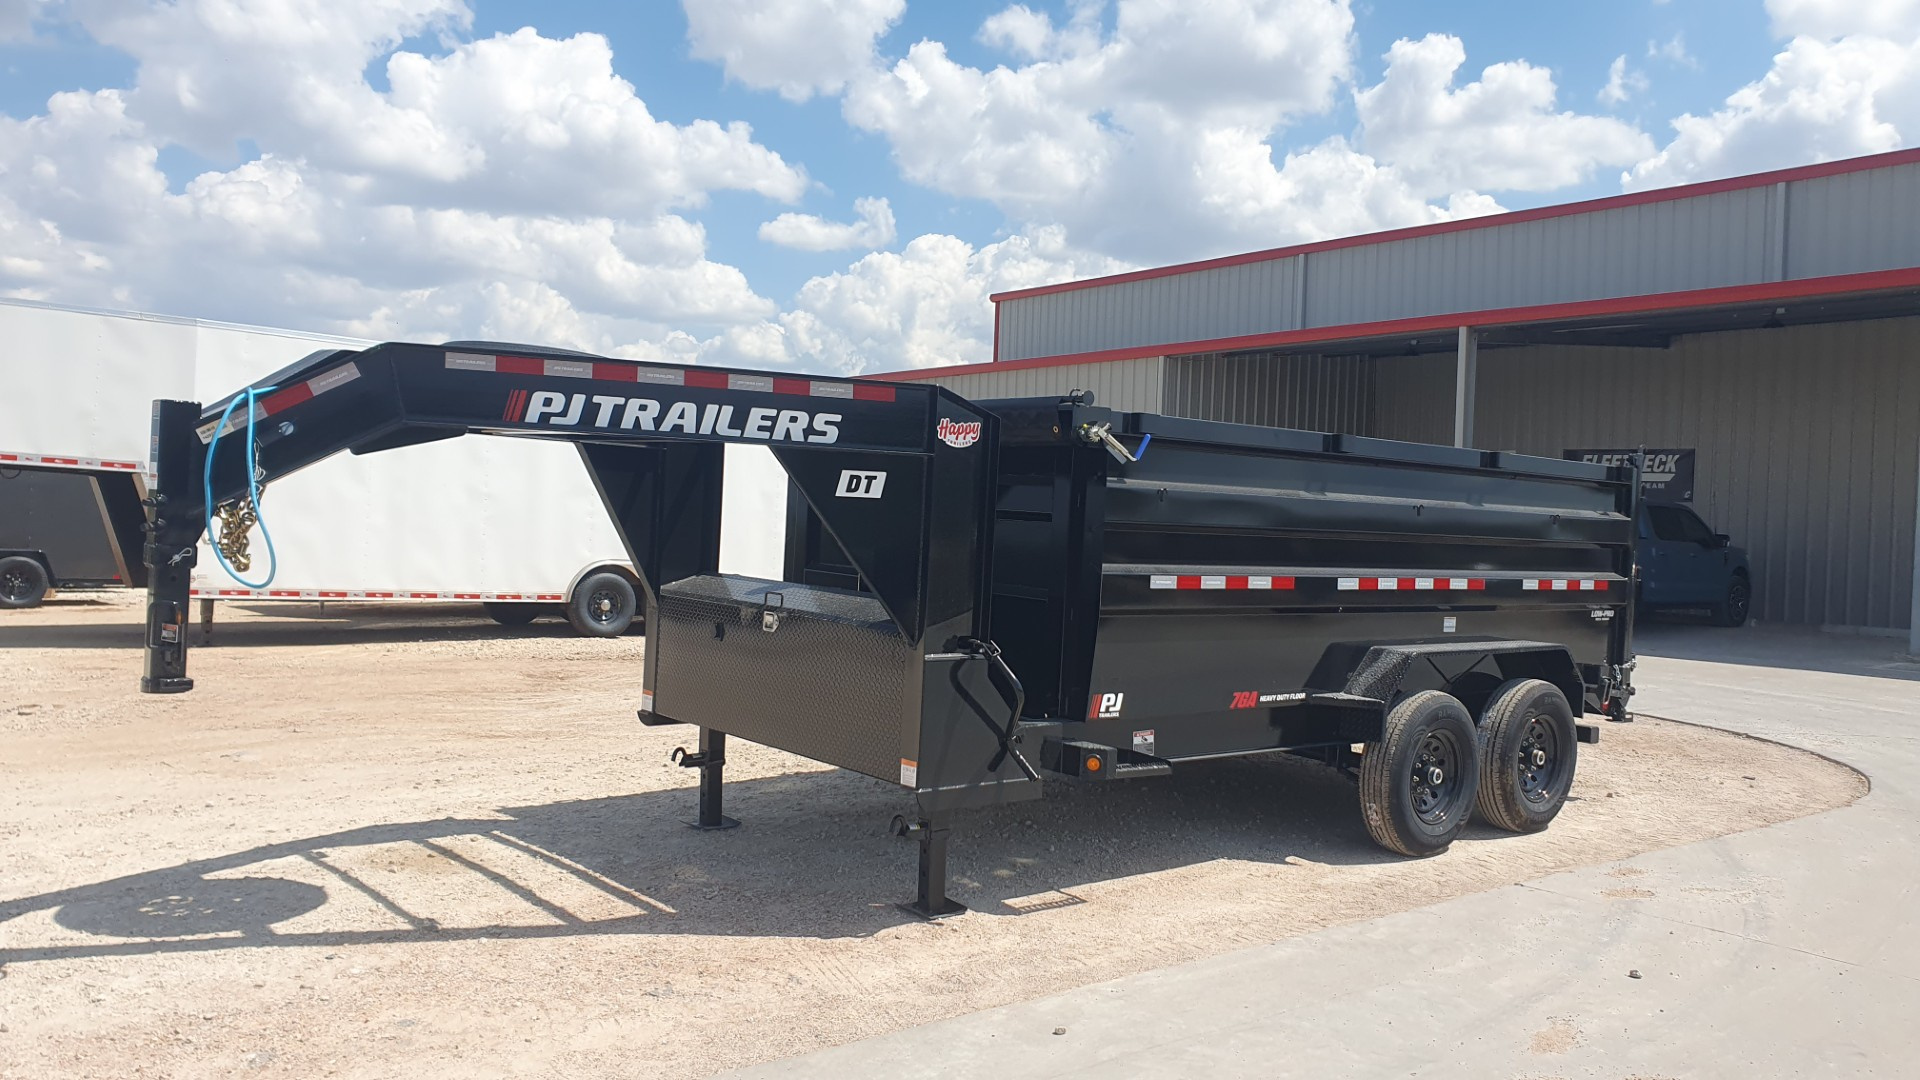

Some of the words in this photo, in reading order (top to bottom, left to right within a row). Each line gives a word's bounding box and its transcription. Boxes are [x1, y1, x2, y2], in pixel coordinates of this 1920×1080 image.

[524, 390, 587, 426] PJ
[592, 395, 843, 444] TRAILERS
[938, 418, 980, 441] Happy
[845, 474, 878, 494] DT
[1099, 692, 1124, 713] PJ
[1259, 694, 1277, 702] HEAVY
[1276, 693, 1290, 701] DUTY
[1289, 692, 1307, 700] FLOOR
